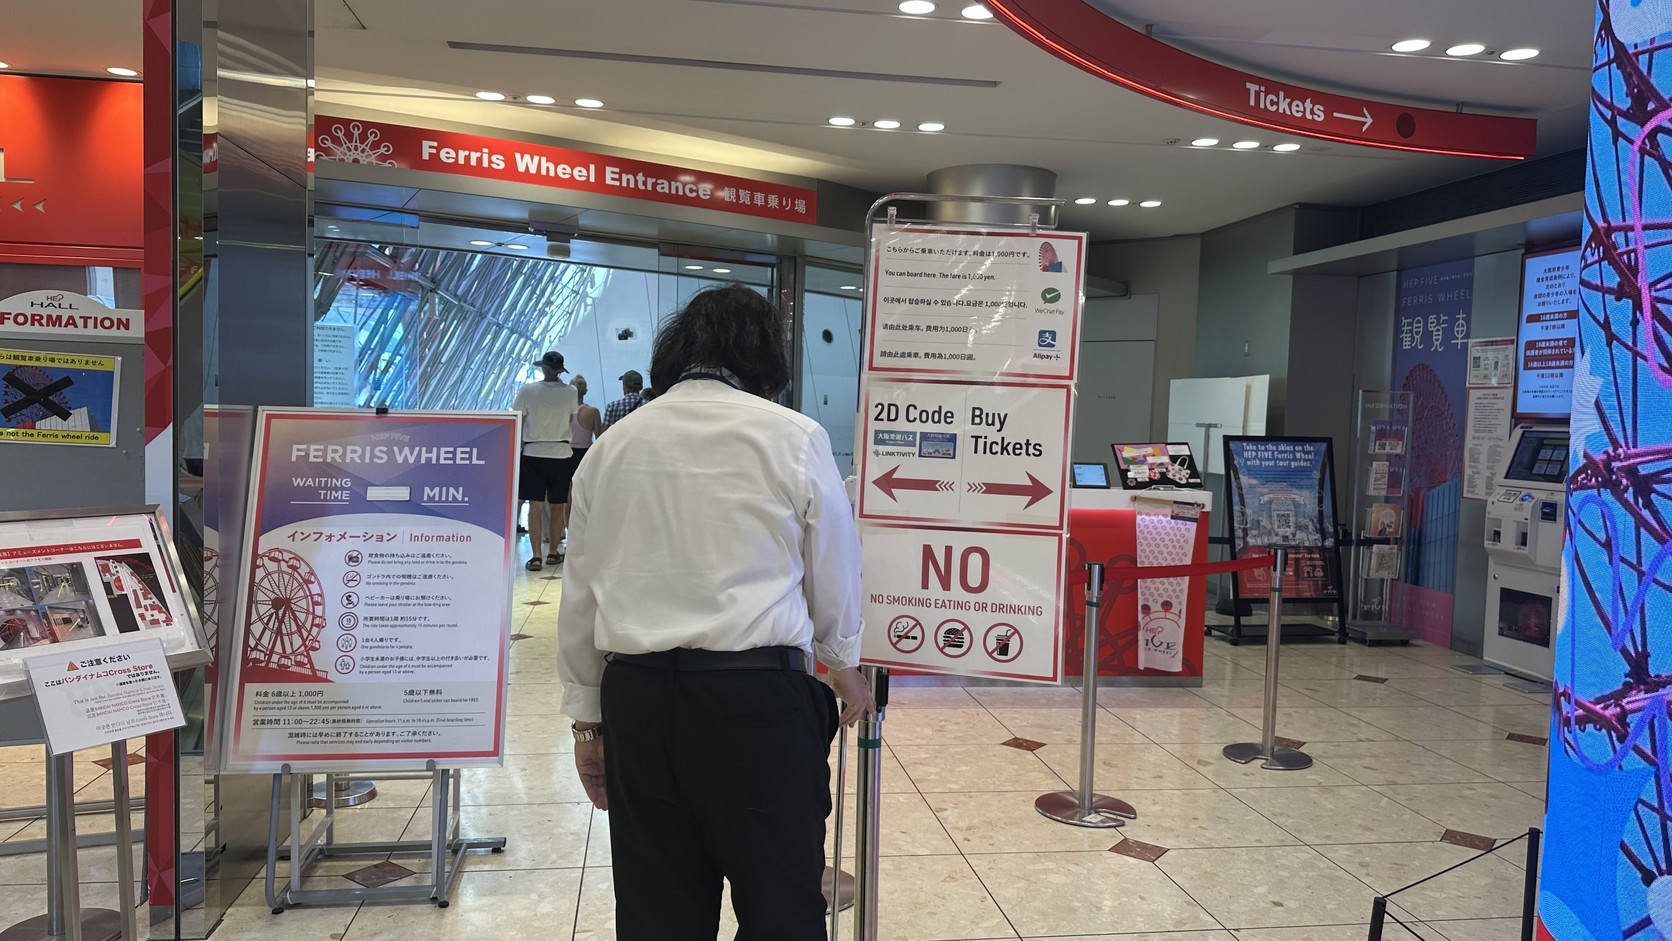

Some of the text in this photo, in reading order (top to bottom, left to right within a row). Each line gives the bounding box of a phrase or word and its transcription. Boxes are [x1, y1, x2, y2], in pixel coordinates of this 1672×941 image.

[1246, 82, 1324, 121] Tickets
[422, 140, 806, 214] Ferris Wheel Entrance 観覧車乗り場
[885, 269, 895, 277] You
[907, 270, 923, 278] board
[950, 272, 961, 280] fare
[962, 272, 967, 280] is
[1403, 278, 1418, 288] HEP
[1420, 275, 1438, 286] FIVE
[883, 296, 907, 305] 이곳에서
[1402, 289, 1471, 307] FERRIS WHEEL
[30, 301, 79, 310] HALL
[1056, 308, 1065, 316] Pay
[1400, 309, 1467, 352] 観覧車
[873, 402, 954, 425] 2D Code
[970, 406, 1008, 432] Buy
[6, 429, 19, 437] not
[22, 430, 34, 438] the
[37, 431, 58, 439] Ferris
[61, 432, 83, 440] wheel
[84, 433, 99, 441] ride
[971, 435, 1043, 457] Tickets
[1242, 442, 1257, 451] Take
[1266, 443, 1277, 451] the
[1278, 443, 1294, 451] skies
[1304, 443, 1313, 451] the
[291, 444, 485, 465] FERRIS WHEEL
[881, 450, 916, 458] LINKTIVITY
[1243, 450, 1314, 460] HEP FIVE Ferris Wheel
[1246, 457, 1260, 466] with
[1261, 460, 1275, 468] your
[1290, 460, 1313, 469] guides.
[292, 477, 351, 488] WAITING
[319, 490, 350, 500] TIME
[423, 486, 469, 502] MIN.
[287, 530, 397, 543] インフォメーション
[410, 532, 472, 543] Information
[921, 543, 990, 594] NO
[870, 593, 1043, 616] NO SMOKING EATING OR DRINKING
[80, 654, 131, 668] ご注意ください
[132, 663, 154, 673] Store
[255, 690, 324, 698] 料金 6歳以上 1,000円
[252, 718, 281, 726] 営業時間
